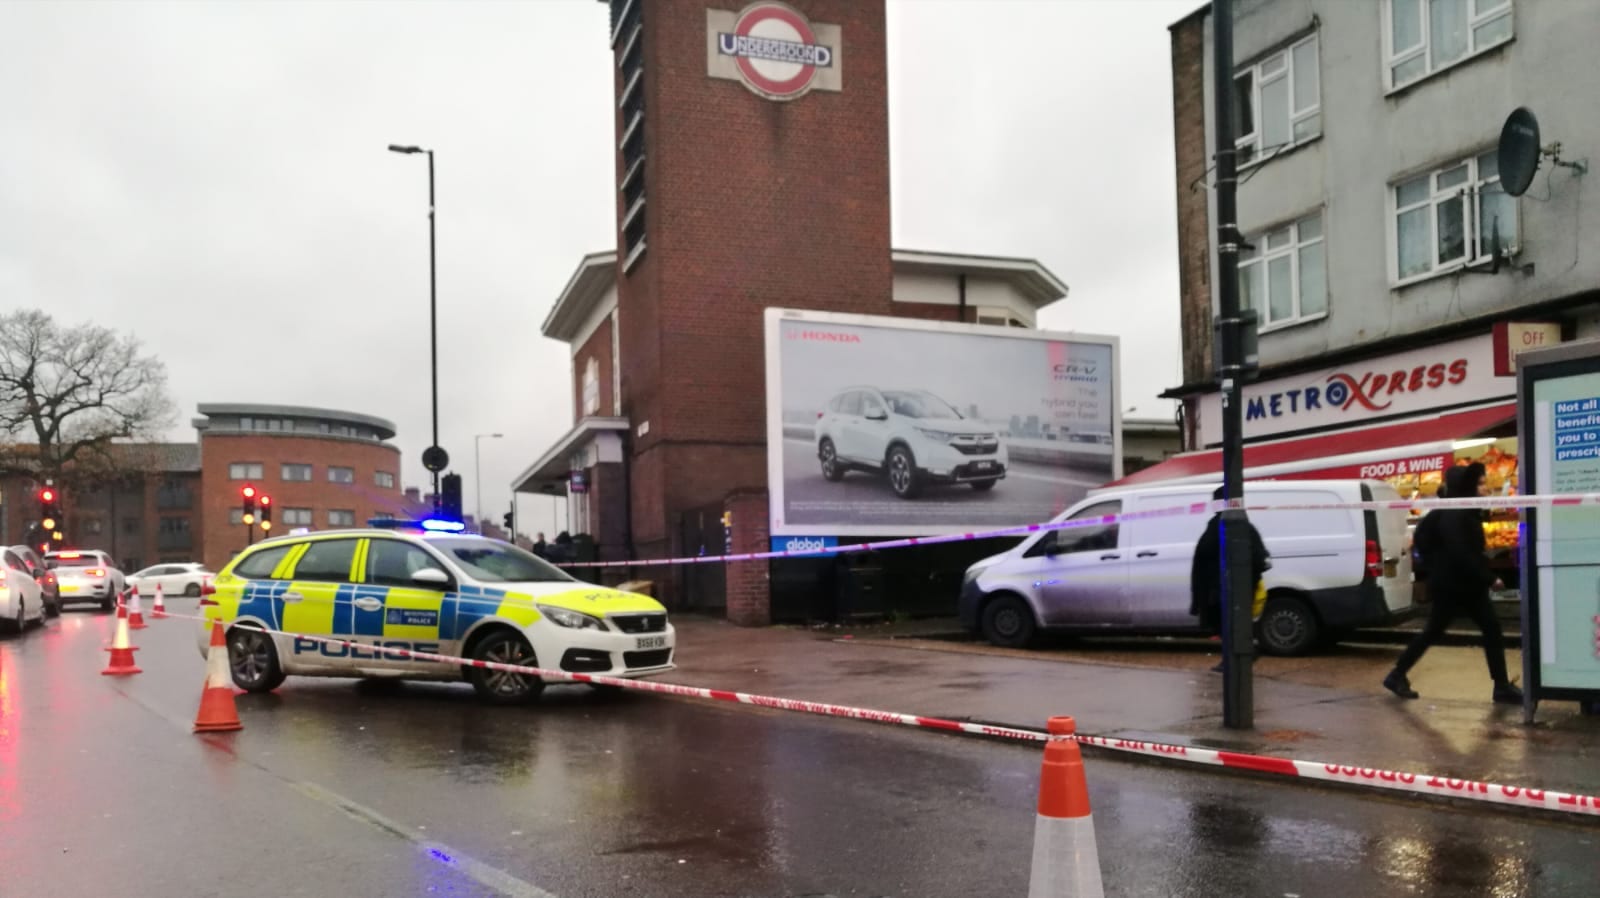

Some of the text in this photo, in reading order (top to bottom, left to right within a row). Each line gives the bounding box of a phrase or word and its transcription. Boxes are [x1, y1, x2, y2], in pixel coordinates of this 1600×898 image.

[720, 34, 831, 66] UNDERGROUND
[802, 330, 861, 342] HONDA
[1522, 331, 1545, 345] OFF
[1558, 400, 1597, 413] Not all
[1559, 432, 1596, 445] you to
[1361, 456, 1444, 478] FOOD & WINE
[294, 637, 440, 662] POLICE
